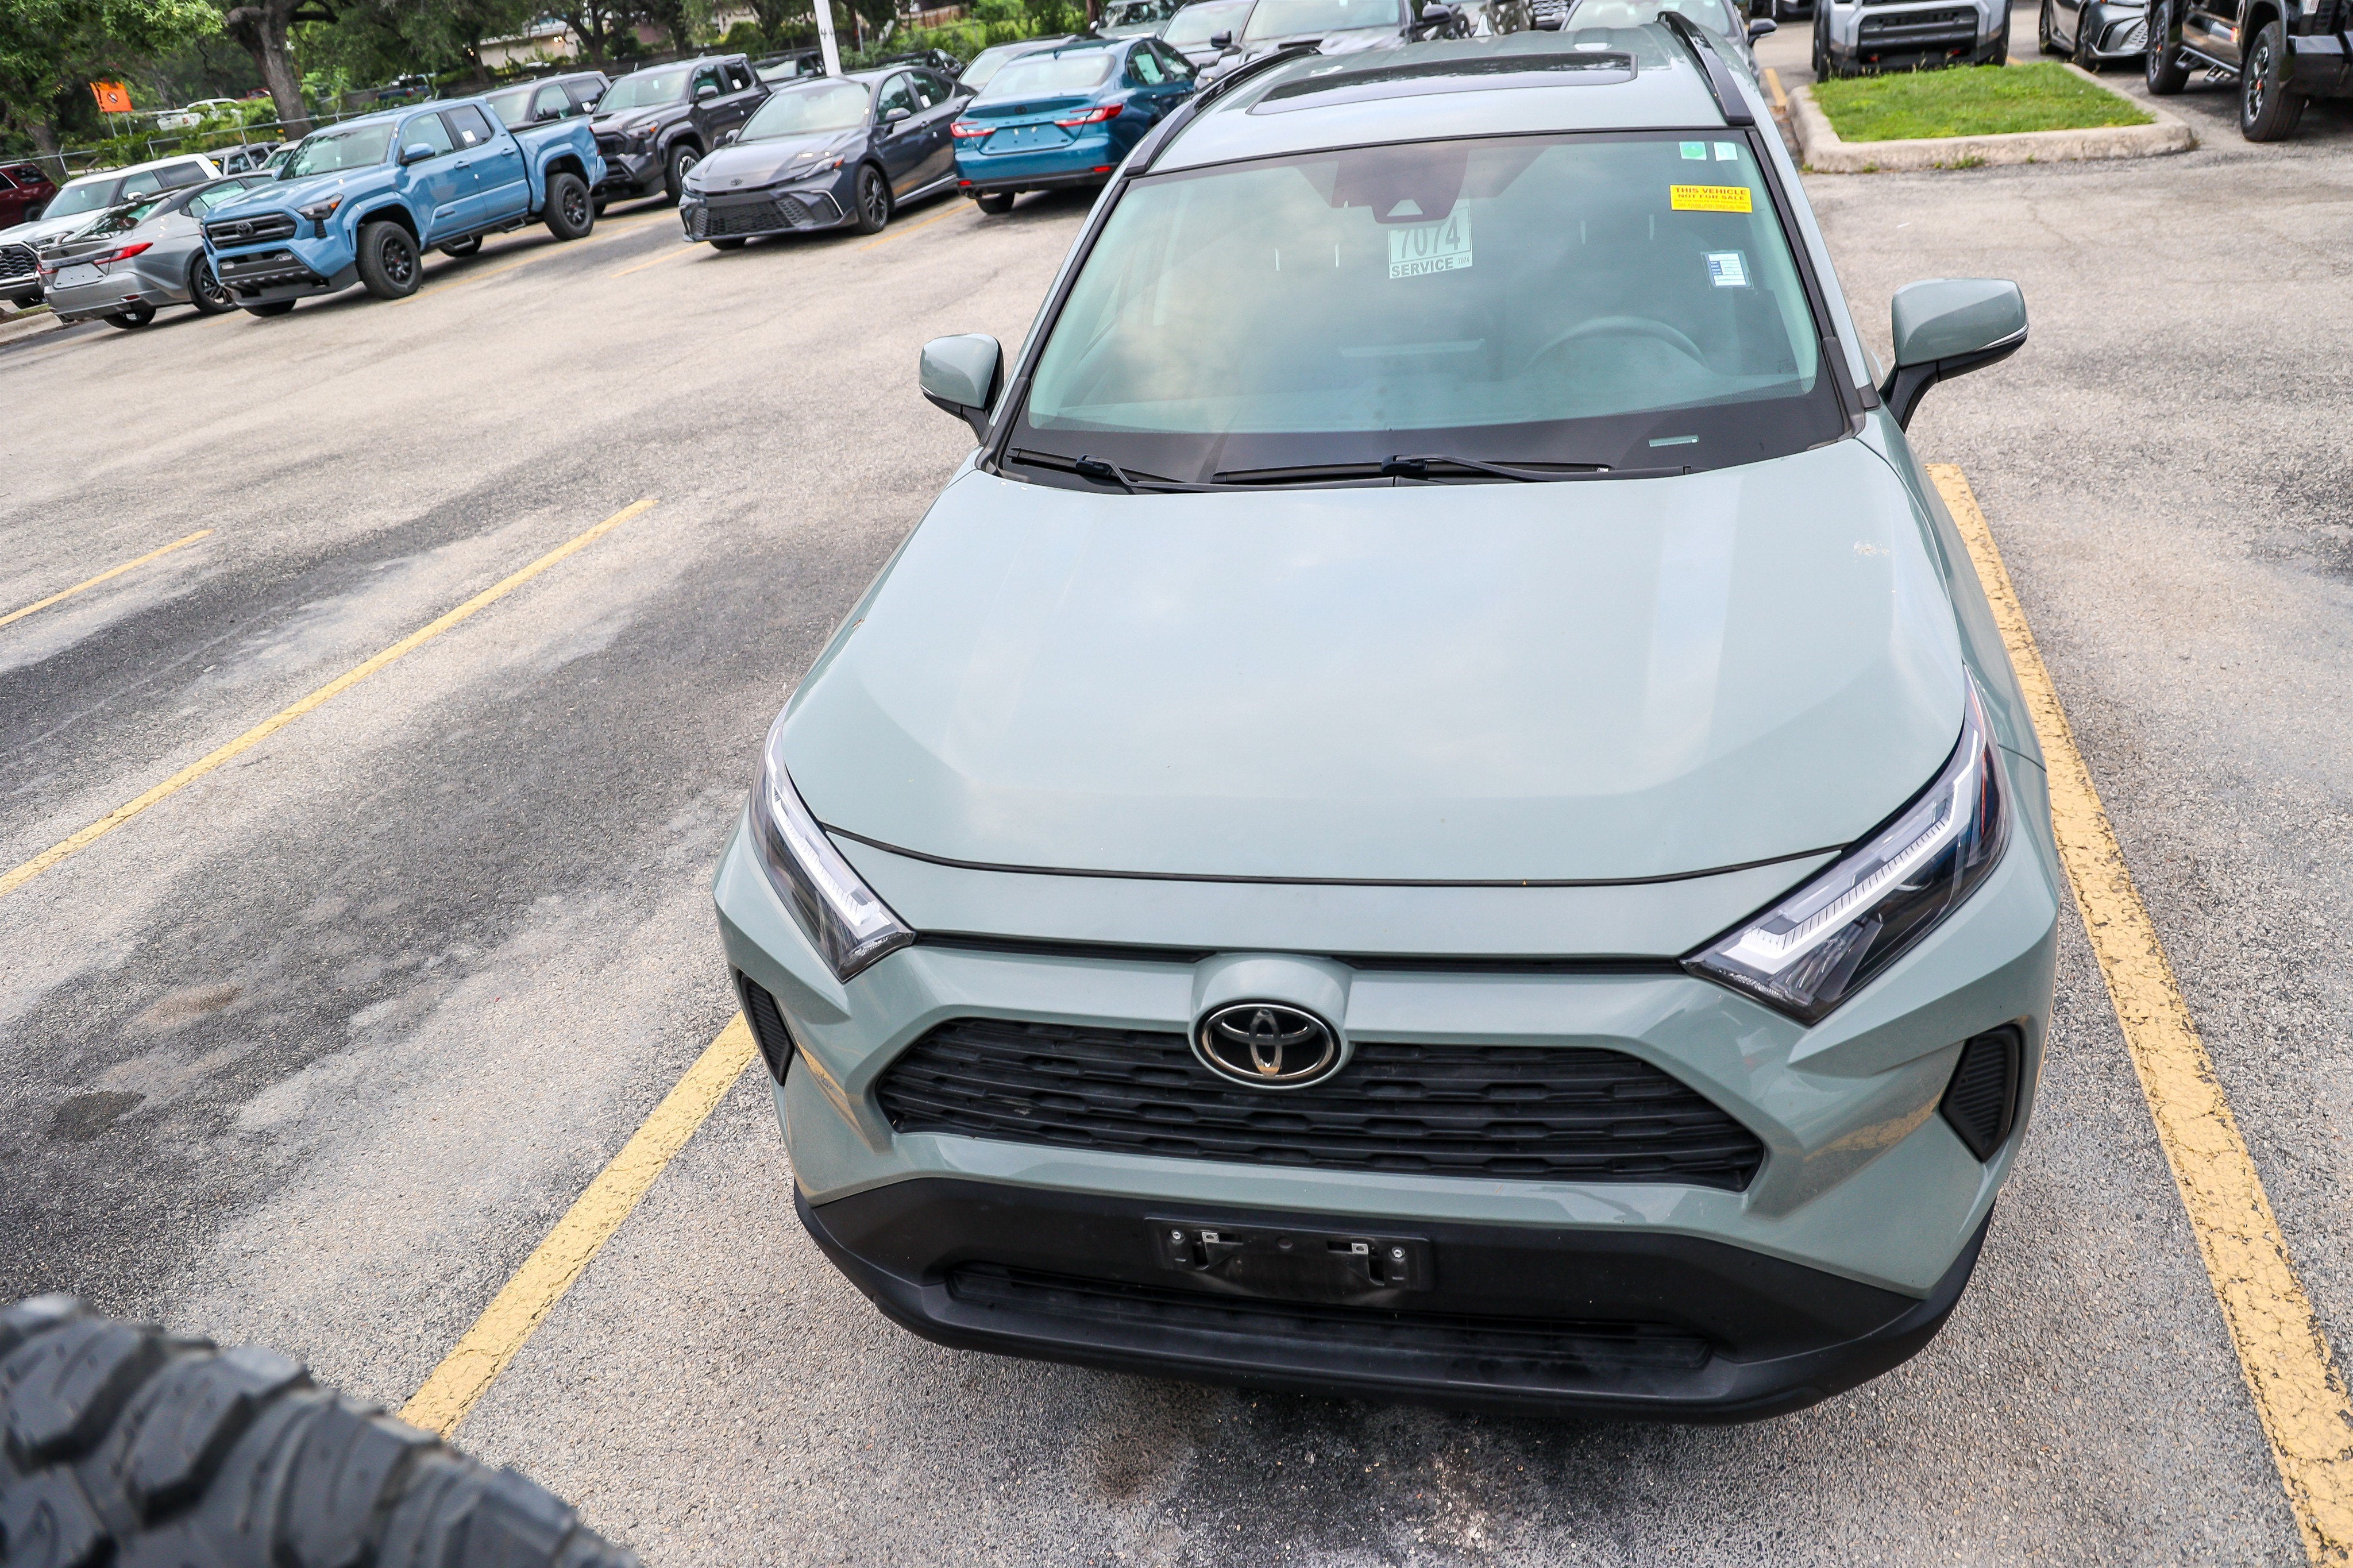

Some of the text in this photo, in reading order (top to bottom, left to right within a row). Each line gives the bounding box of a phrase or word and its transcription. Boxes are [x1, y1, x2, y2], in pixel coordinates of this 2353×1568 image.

[1398, 216, 1460, 258] 7074
[1391, 256, 1469, 277] SERVICE 7074
